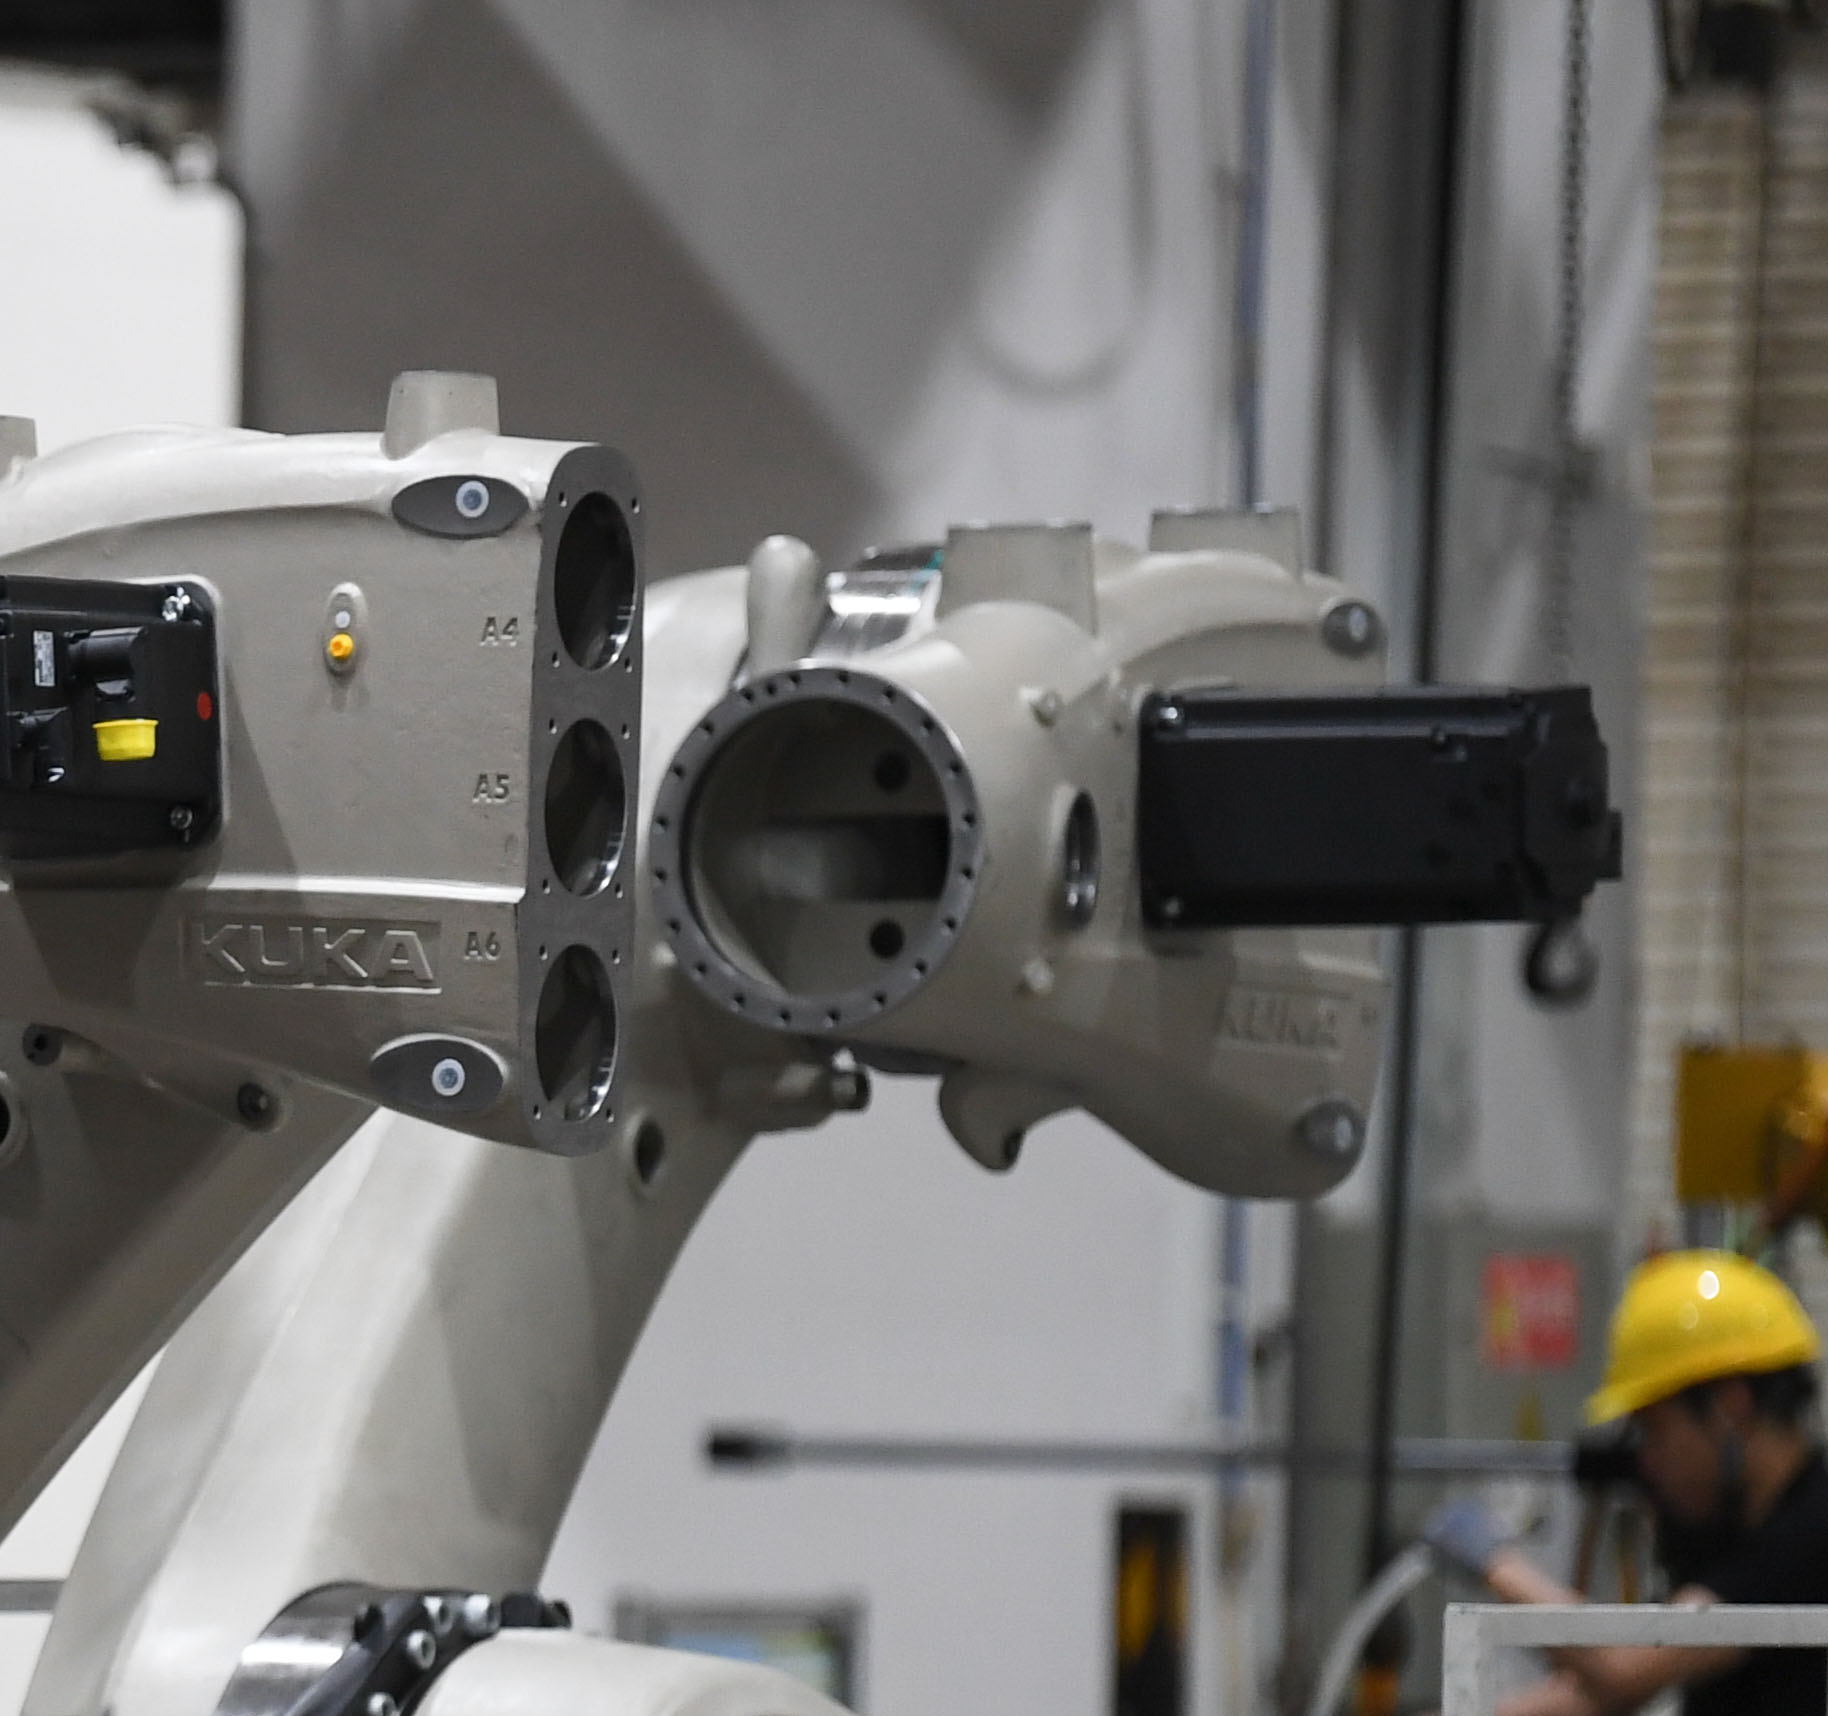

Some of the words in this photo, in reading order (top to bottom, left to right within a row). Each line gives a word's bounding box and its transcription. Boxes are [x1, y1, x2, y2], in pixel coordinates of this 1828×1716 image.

[478, 615, 522, 647] A4
[472, 772, 513, 804] A5
[199, 923, 437, 984] KUKA
[464, 930, 503, 961] A6
